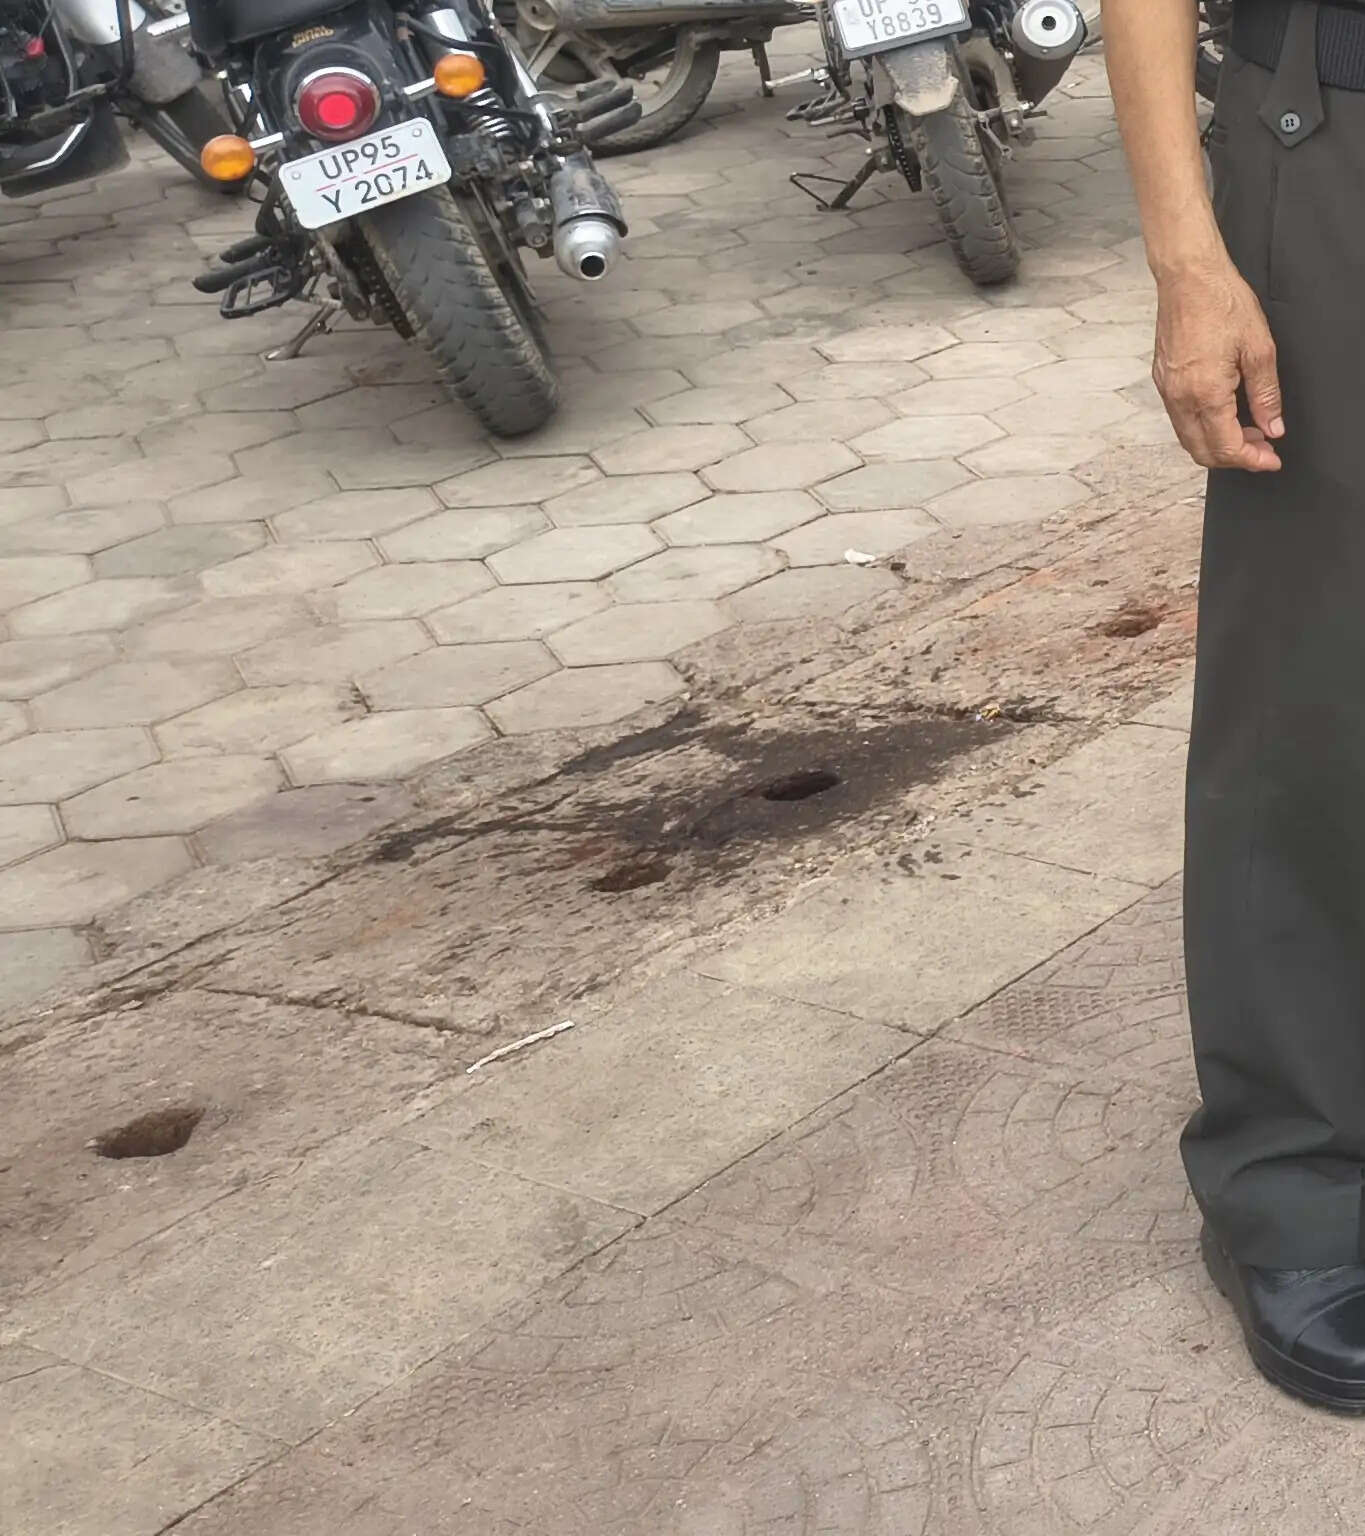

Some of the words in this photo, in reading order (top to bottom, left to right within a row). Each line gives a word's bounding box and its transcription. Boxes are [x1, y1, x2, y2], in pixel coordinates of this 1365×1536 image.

[866, 3, 943, 41] Y8839
[318, 135, 401, 180] UP95
[321, 189, 342, 214] Y
[354, 159, 434, 204] 2074
